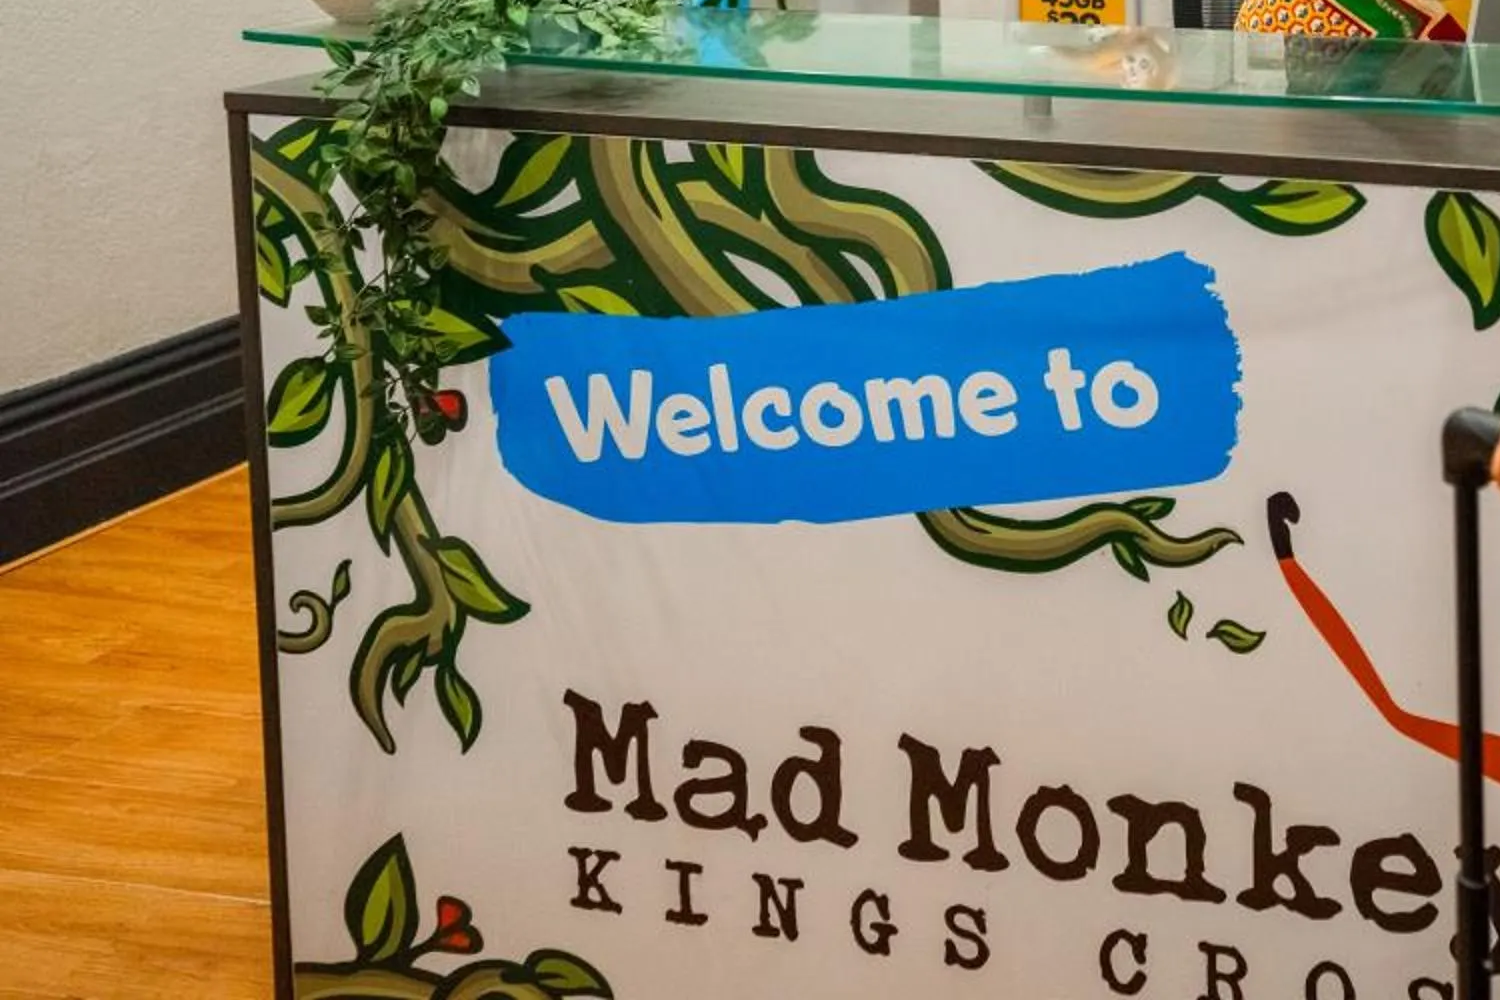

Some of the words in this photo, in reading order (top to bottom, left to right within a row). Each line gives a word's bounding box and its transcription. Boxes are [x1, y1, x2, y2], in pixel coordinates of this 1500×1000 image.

[544, 363, 1020, 462] Welcome
[1044, 348, 1159, 432] to
[563, 688, 859, 849] Mad
[568, 846, 991, 970] KINGS
